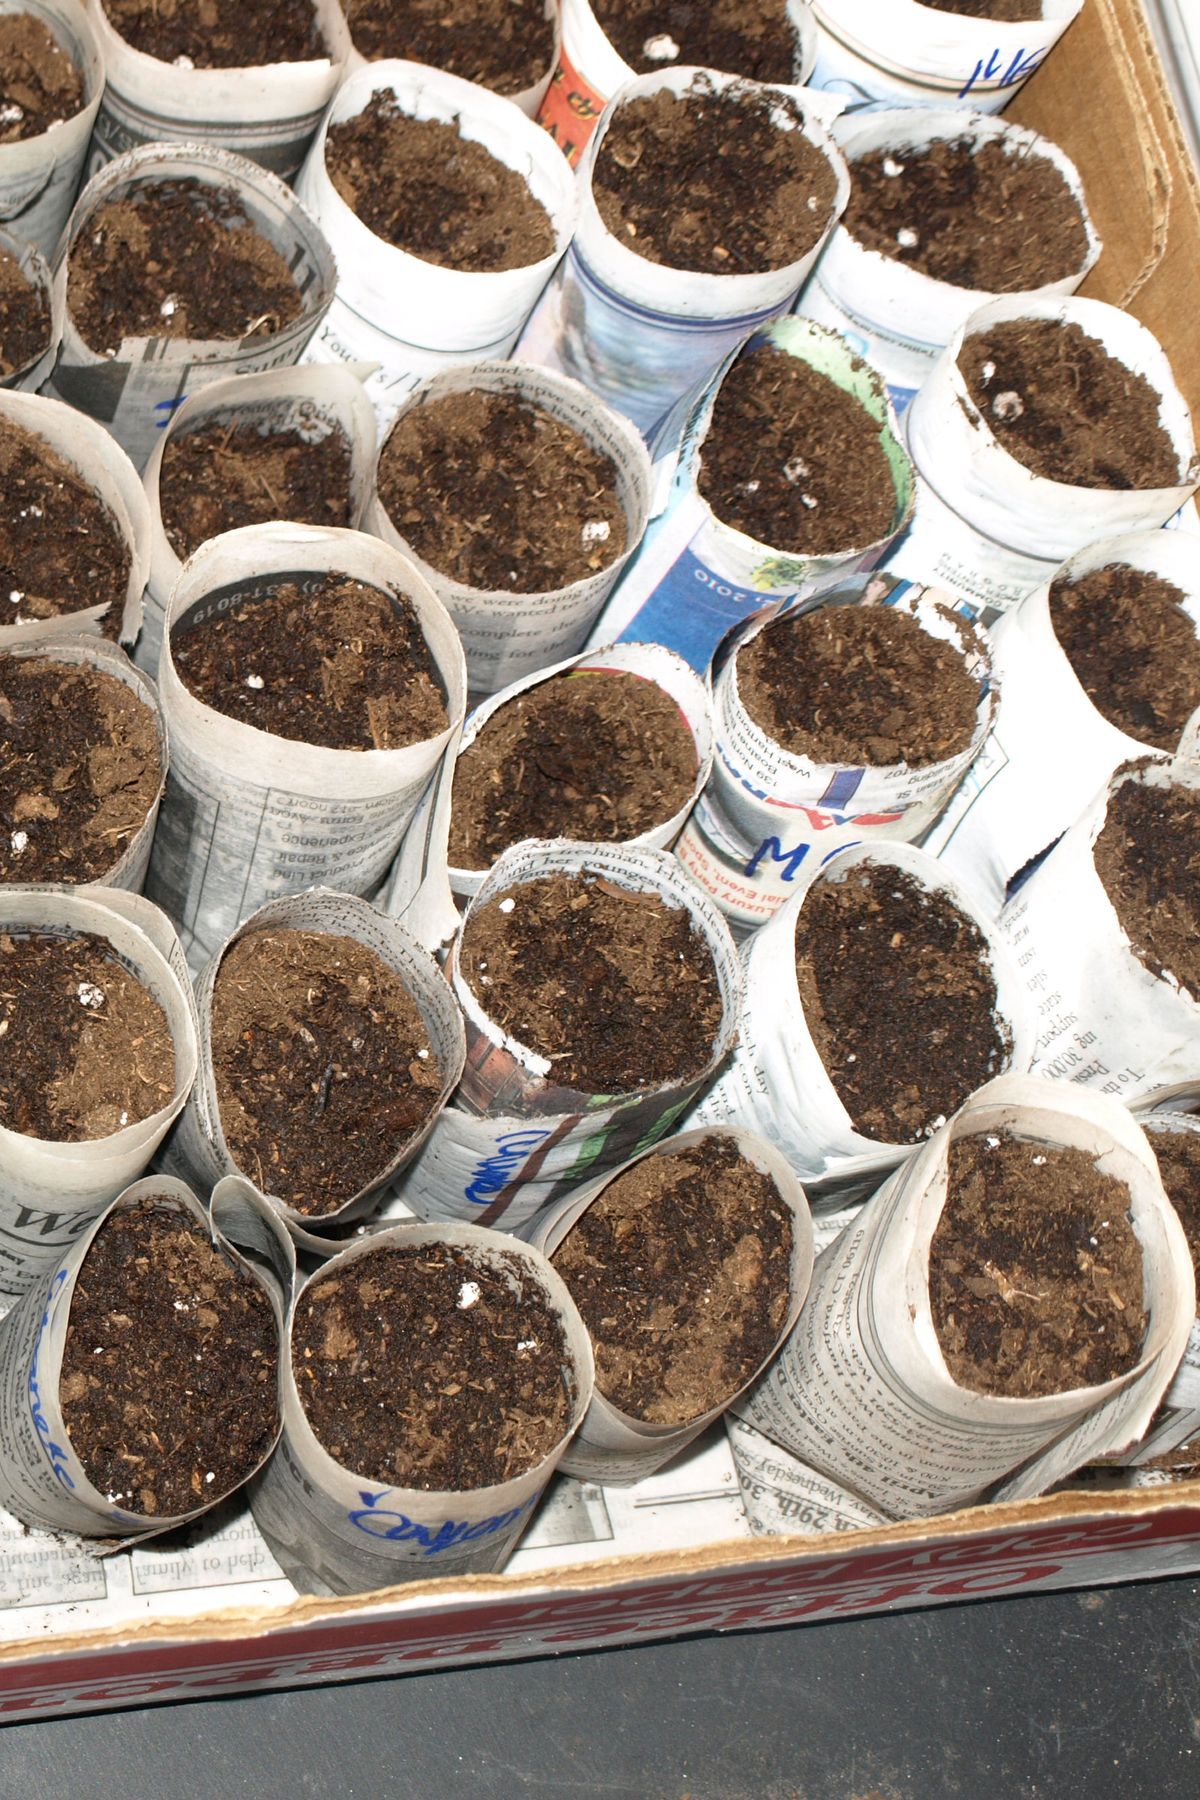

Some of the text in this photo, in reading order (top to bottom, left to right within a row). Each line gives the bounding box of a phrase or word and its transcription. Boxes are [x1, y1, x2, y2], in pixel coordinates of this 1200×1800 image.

[694, 568, 748, 603] 2010
[492, 604, 557, 618] wanted
[583, 860, 664, 890] youngest
[688, 861, 779, 918] Luxury Party
[753, 1065, 770, 1096] day
[755, 1456, 844, 1507] Wednesday
[881, 1474, 944, 1500] April
[495, 1519, 1152, 1624] copy paper
